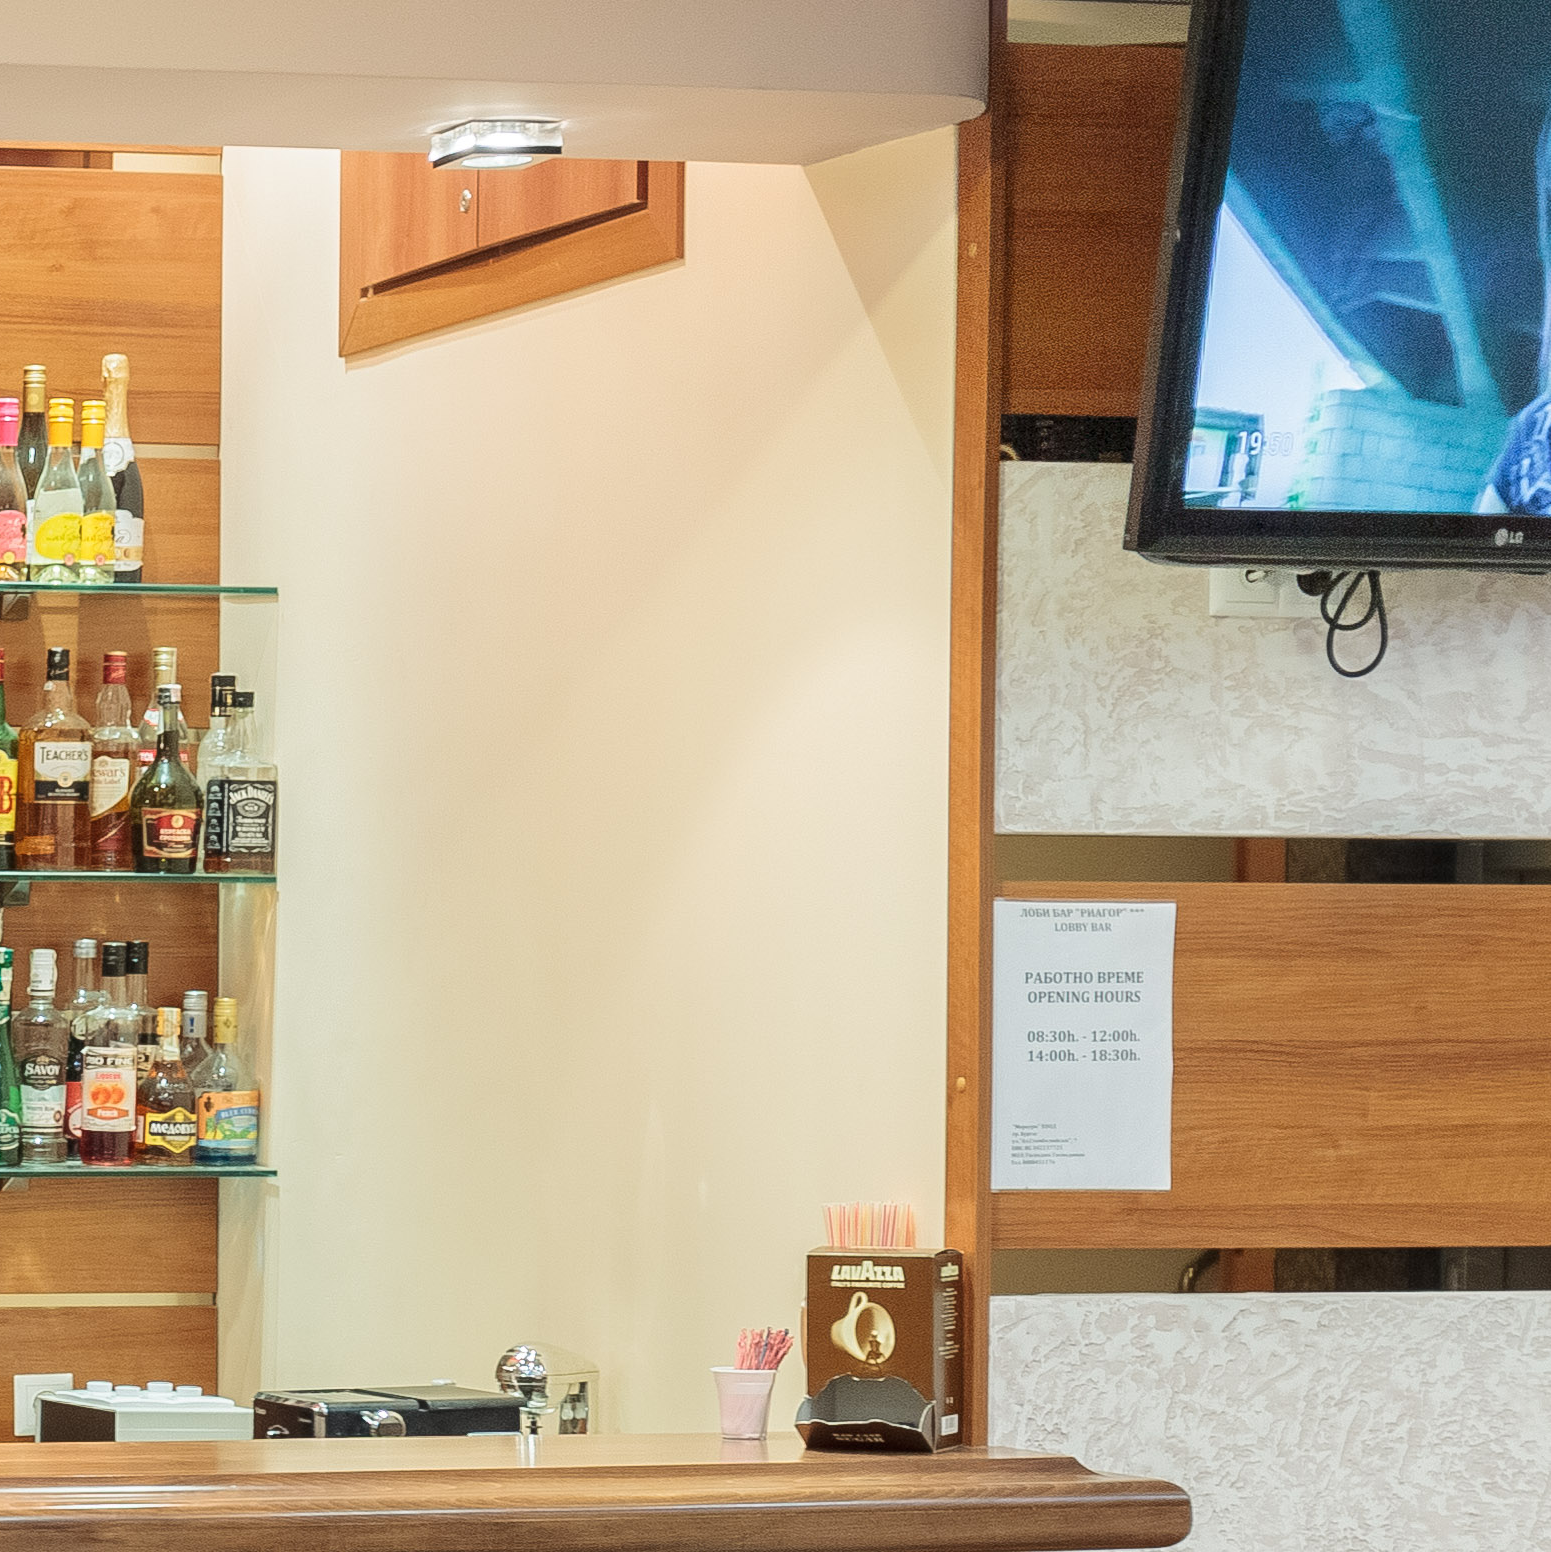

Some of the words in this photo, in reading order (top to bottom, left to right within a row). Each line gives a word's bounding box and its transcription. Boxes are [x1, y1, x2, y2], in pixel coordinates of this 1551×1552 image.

[39, 746, 89, 764] TEACHER'S
[93, 765, 127, 778] ewar's
[1020, 908, 1050, 918] ЛОБИ
[1053, 908, 1074, 918] БАР
[1054, 922, 1088, 932] LOBBY
[1091, 922, 1112, 932] BAR
[1025, 972, 1094, 984] РАБОТНО
[1097, 971, 1144, 984] ВРЕМЕ
[1027, 991, 1090, 1003] OPENING
[1094, 990, 1142, 1003] HOURS
[1027, 1029, 1079, 1043] 08:30h.
[1091, 1029, 1140, 1043] 12:00h.
[1027, 1049, 1079, 1062] 14:00h.
[1091, 1049, 1141, 1062] 18:30h.
[24, 1062, 61, 1077] SAVOY
[830, 1260, 906, 1282] LAVAZZA
